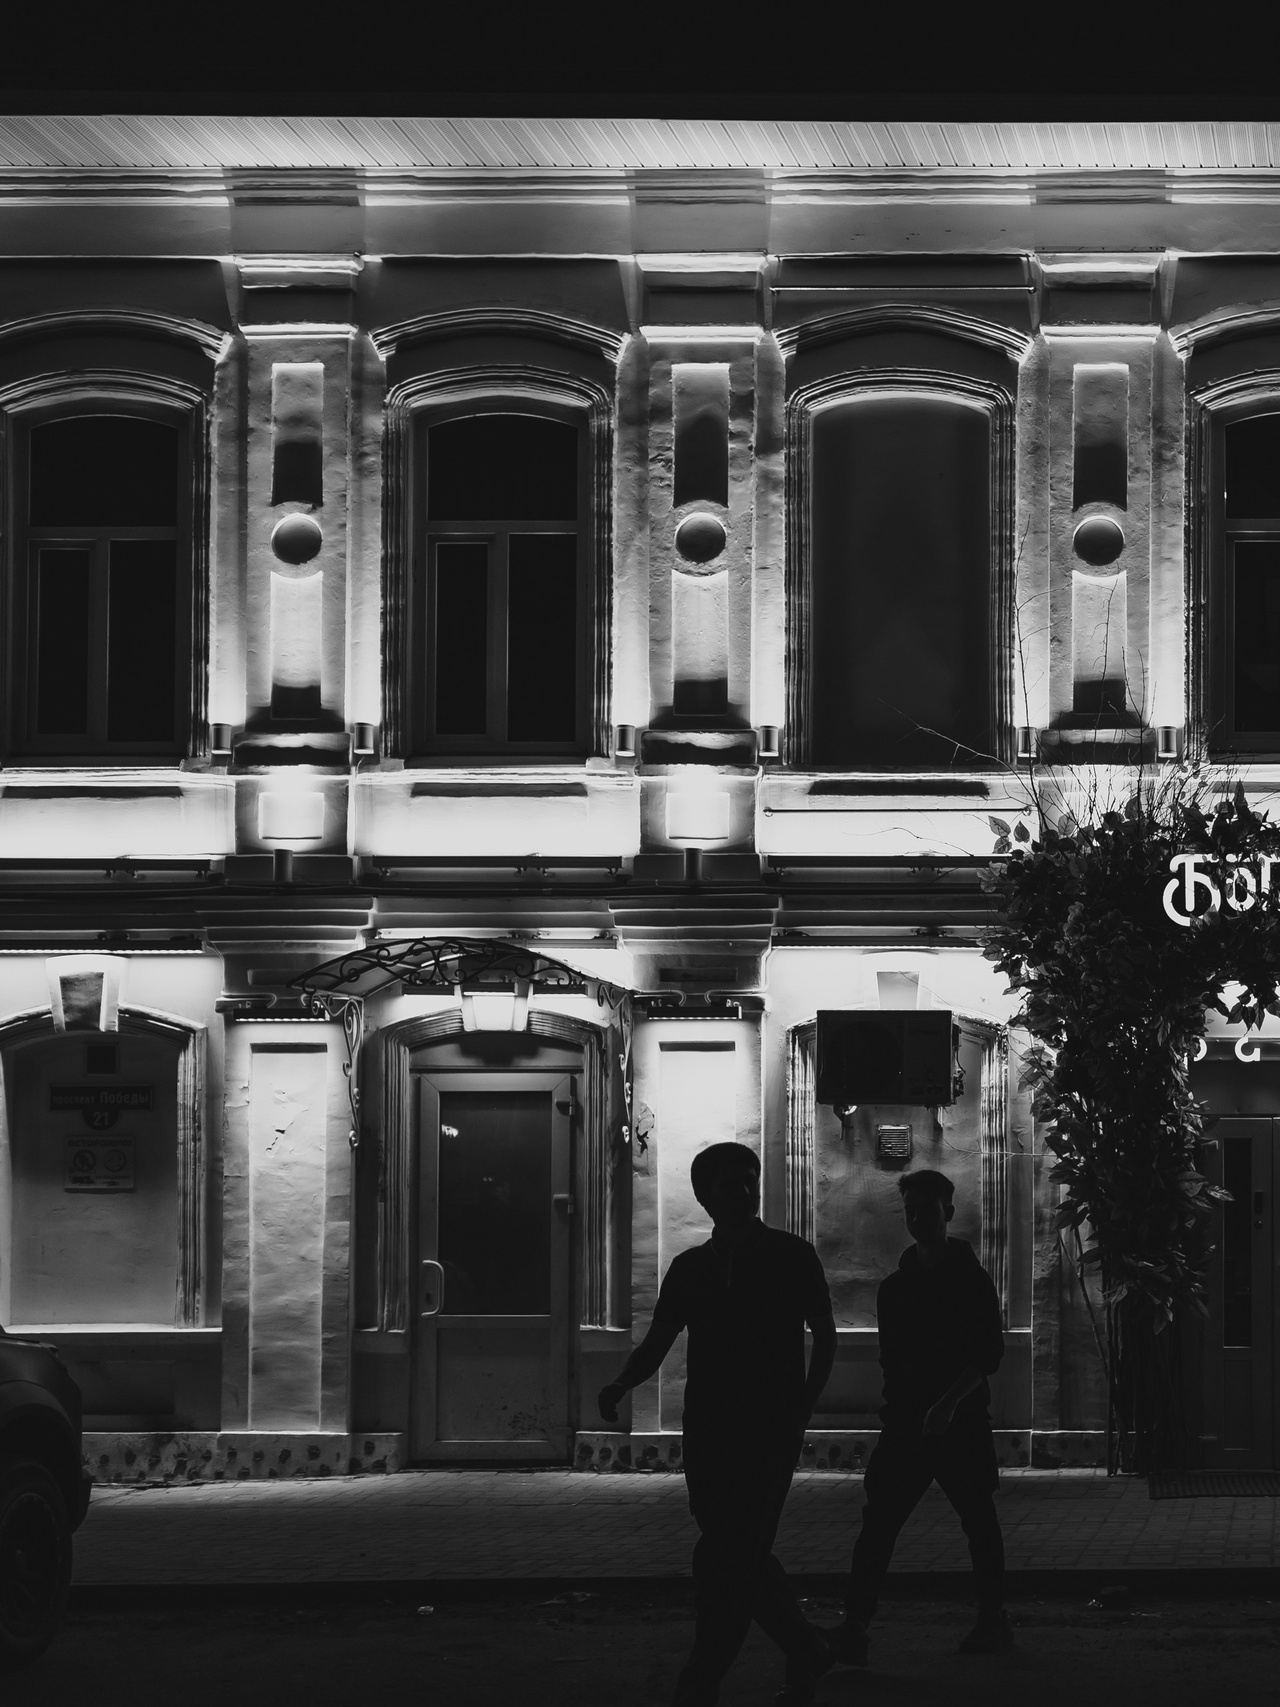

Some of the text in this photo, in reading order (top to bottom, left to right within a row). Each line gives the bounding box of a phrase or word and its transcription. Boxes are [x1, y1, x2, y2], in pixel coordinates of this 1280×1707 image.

[52, 1091, 148, 1105] проспект Победы
[93, 1111, 109, 1126] 21
